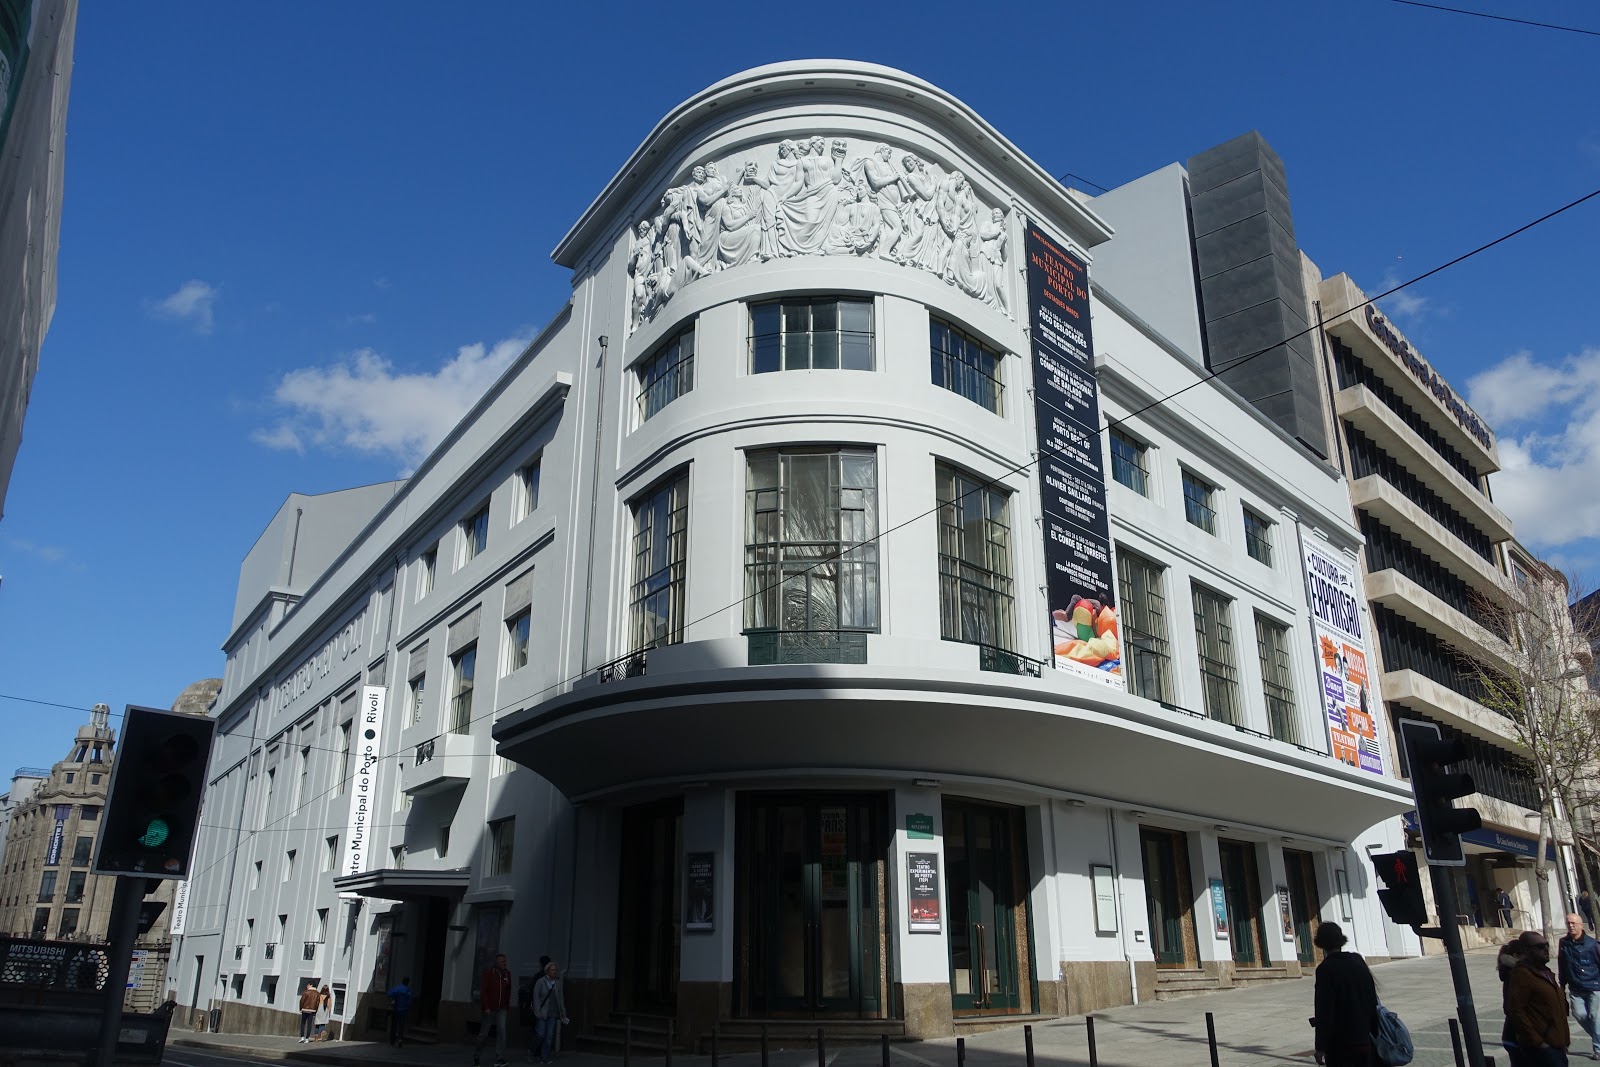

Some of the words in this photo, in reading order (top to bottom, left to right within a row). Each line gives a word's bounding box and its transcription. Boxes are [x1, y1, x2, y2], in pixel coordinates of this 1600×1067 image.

[1031, 252, 1074, 292] MUNICIPAL
[1076, 284, 1086, 301] DO
[1044, 250, 1074, 282] TEATRO
[1047, 275, 1073, 302] PORTO
[1039, 308, 1052, 325] FOCO
[1053, 318, 1087, 349] DESLOCAÇÕES
[1039, 356, 1069, 382] COMPANHIA
[1069, 375, 1093, 398] NACIONAL
[1053, 374, 1060, 385] DE
[1060, 378, 1082, 399] BAILADO
[1052, 421, 1069, 438] PORTO
[1070, 432, 1082, 446] BEST
[1083, 439, 1090, 451] OF
[1045, 474, 1066, 492] OLIVIER
[1067, 485, 1091, 505] SAILLARD
[1050, 529, 1057, 540] EL
[1058, 533, 1075, 548] CONDE
[1075, 541, 1082, 552] DE
[1083, 544, 1108, 564] TORREFIEL
[1312, 553, 1340, 586] CULTURA
[1309, 570, 1362, 640] EXPANSÃO
[366, 693, 379, 723] Rivoli
[1332, 730, 1355, 748] TEATRO
[360, 745, 373, 774] Porto
[361, 777, 369, 792] do
[352, 794, 368, 850] Municipal
[174, 910, 183, 930] Teatro
[9, 944, 67, 956] MITSUBISHI
